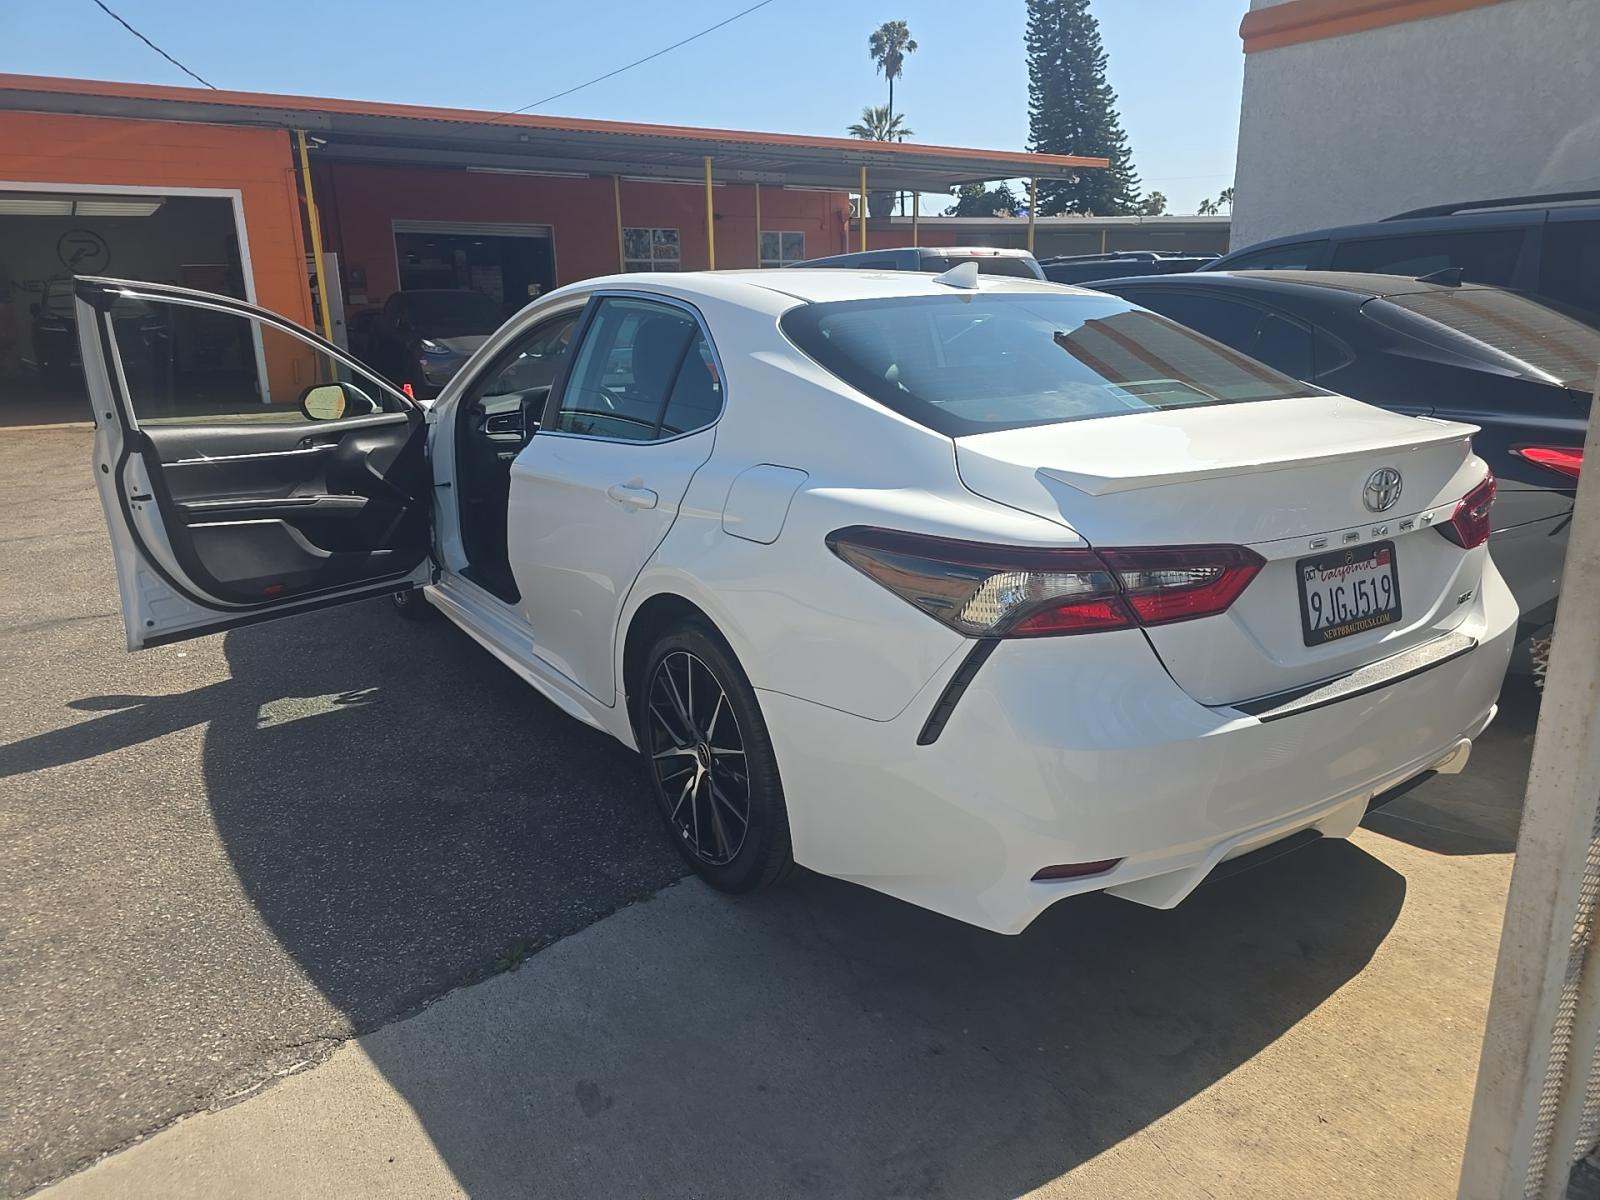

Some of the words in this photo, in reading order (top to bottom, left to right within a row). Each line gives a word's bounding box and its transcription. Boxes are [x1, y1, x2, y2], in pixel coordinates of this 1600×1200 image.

[1305, 568, 1316, 582] OCT
[1321, 560, 1377, 583] California
[1310, 574, 1391, 630] 9JGJ519
